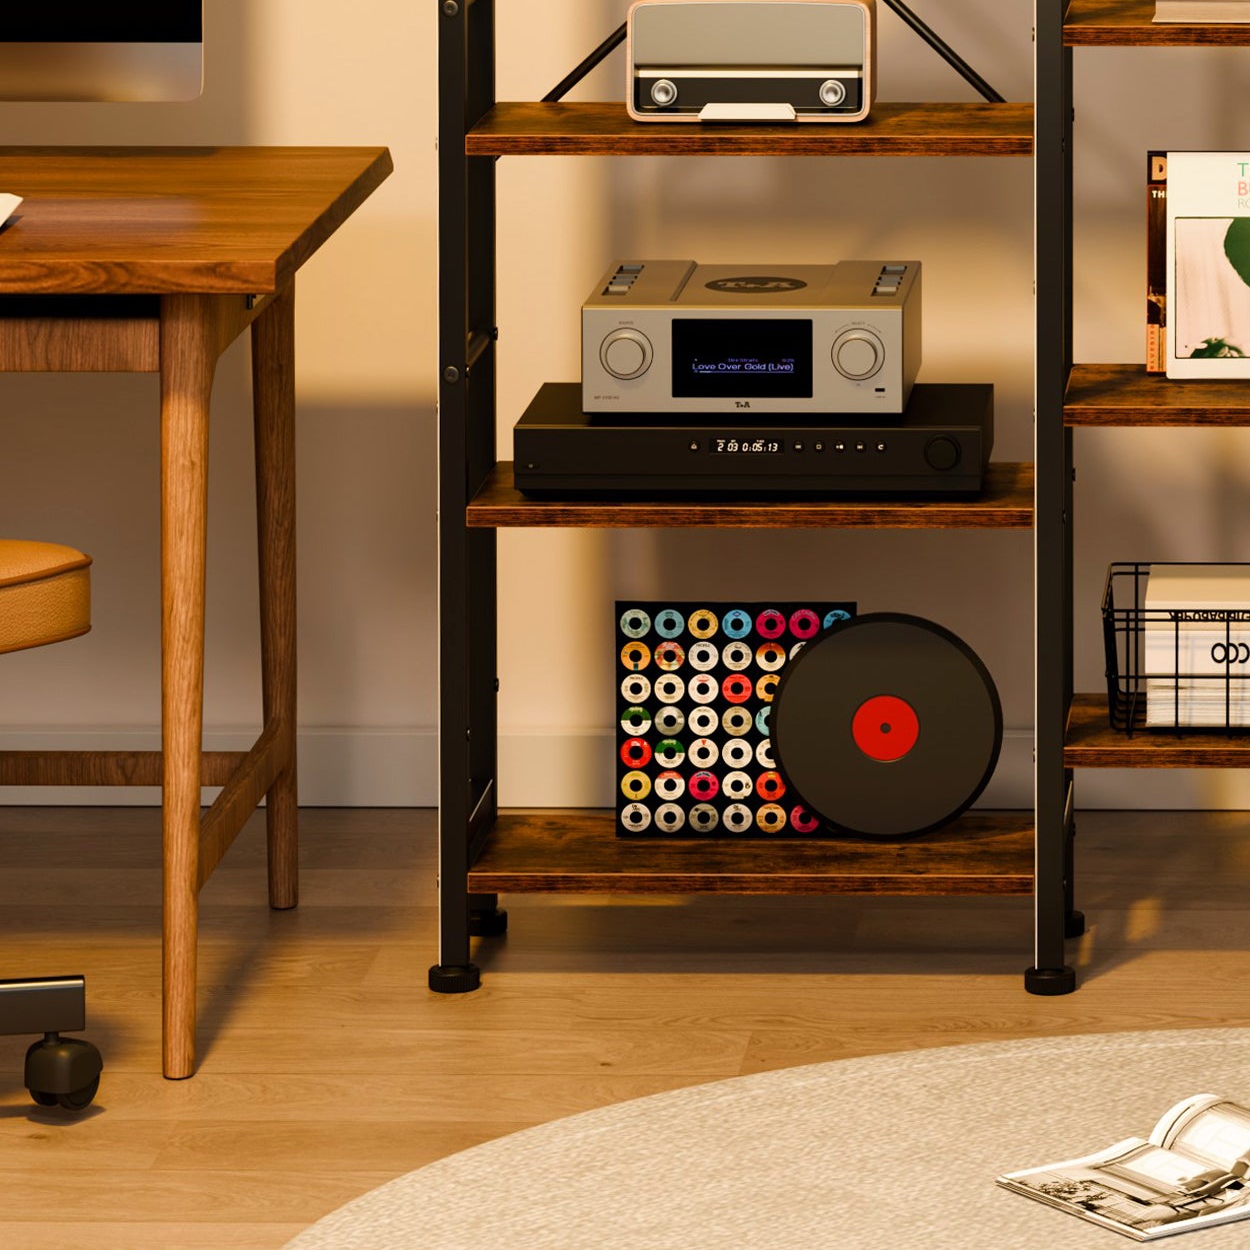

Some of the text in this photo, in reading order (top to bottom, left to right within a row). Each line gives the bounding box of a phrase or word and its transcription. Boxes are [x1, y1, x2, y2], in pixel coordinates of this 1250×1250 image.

[768, 363, 794, 372] (Live)
[717, 443, 724, 452] 2
[727, 443, 738, 452] 03
